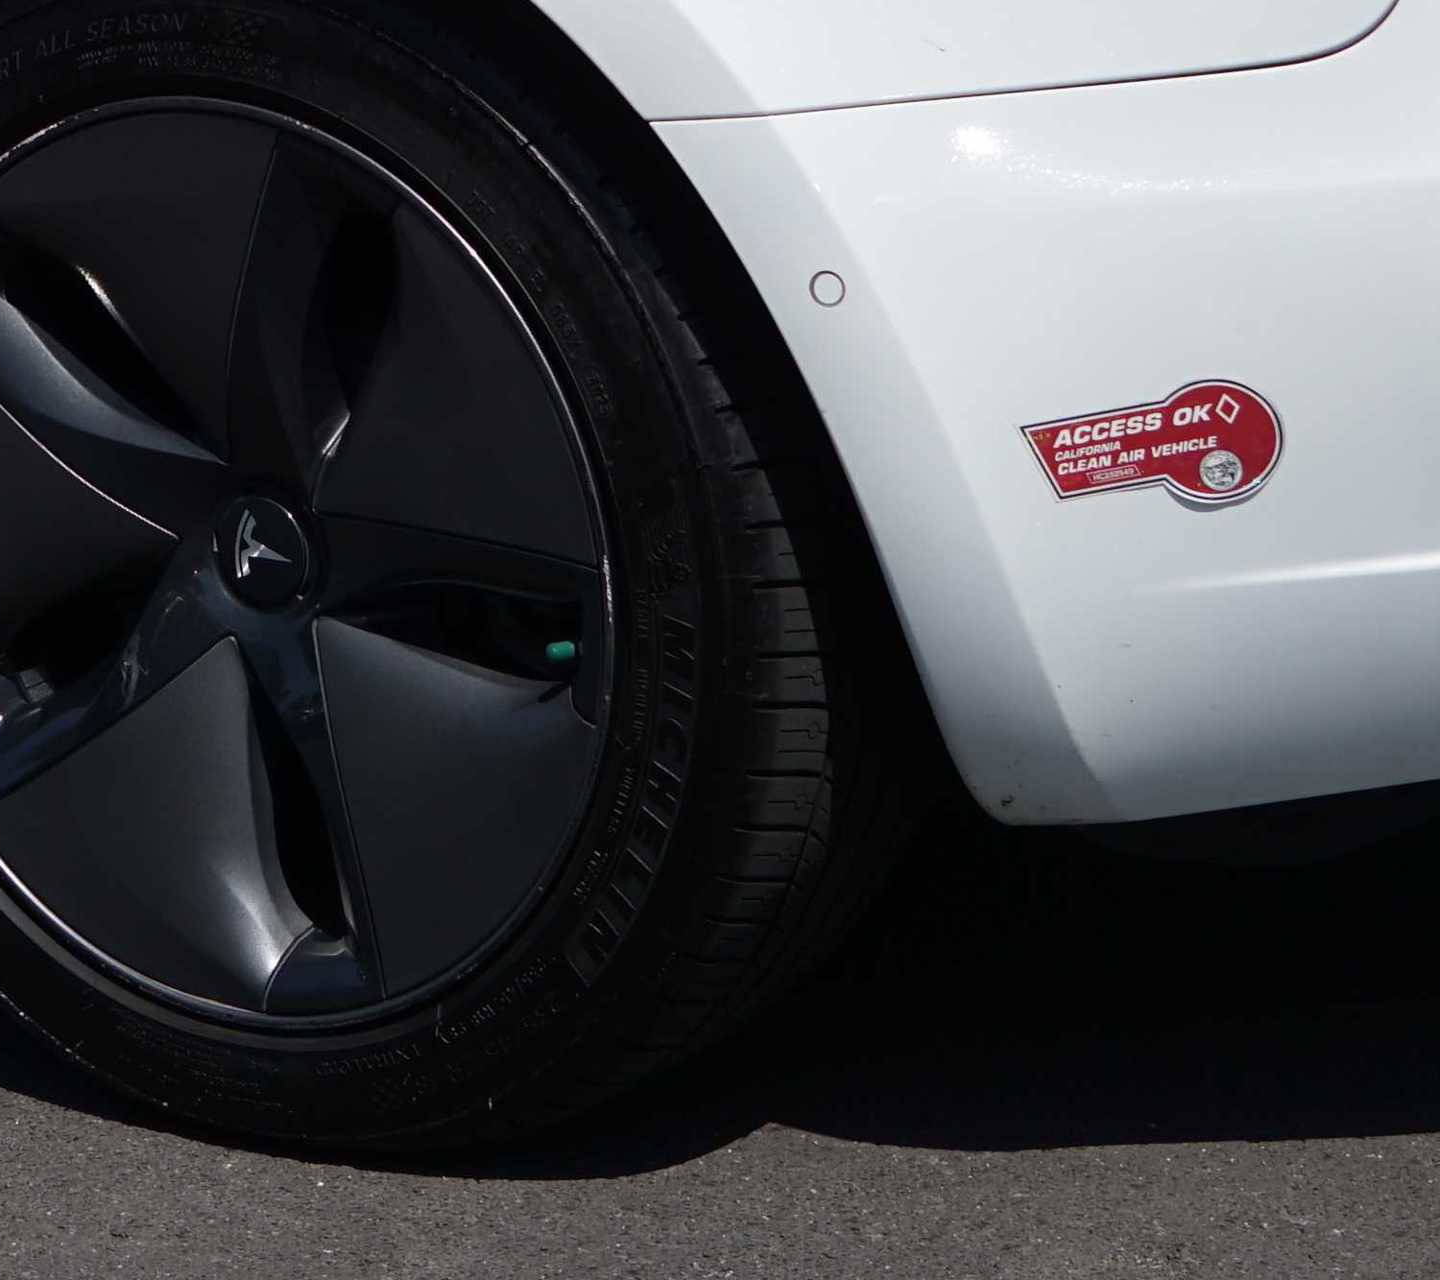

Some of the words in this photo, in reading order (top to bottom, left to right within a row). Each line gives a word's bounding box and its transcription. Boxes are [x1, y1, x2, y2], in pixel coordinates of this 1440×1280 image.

[31, 25, 80, 63] ALL
[82, 9, 191, 44] SEASON
[1053, 413, 1163, 448] ACCESS
[1172, 403, 1212, 426] OK
[1055, 441, 1121, 461] CALIFORNIA
[1058, 455, 1112, 475] CLEAN
[1117, 448, 1145, 465] AIR
[1151, 436, 1218, 458] VEHICLE
[579, 611, 697, 966] MICHELIN
